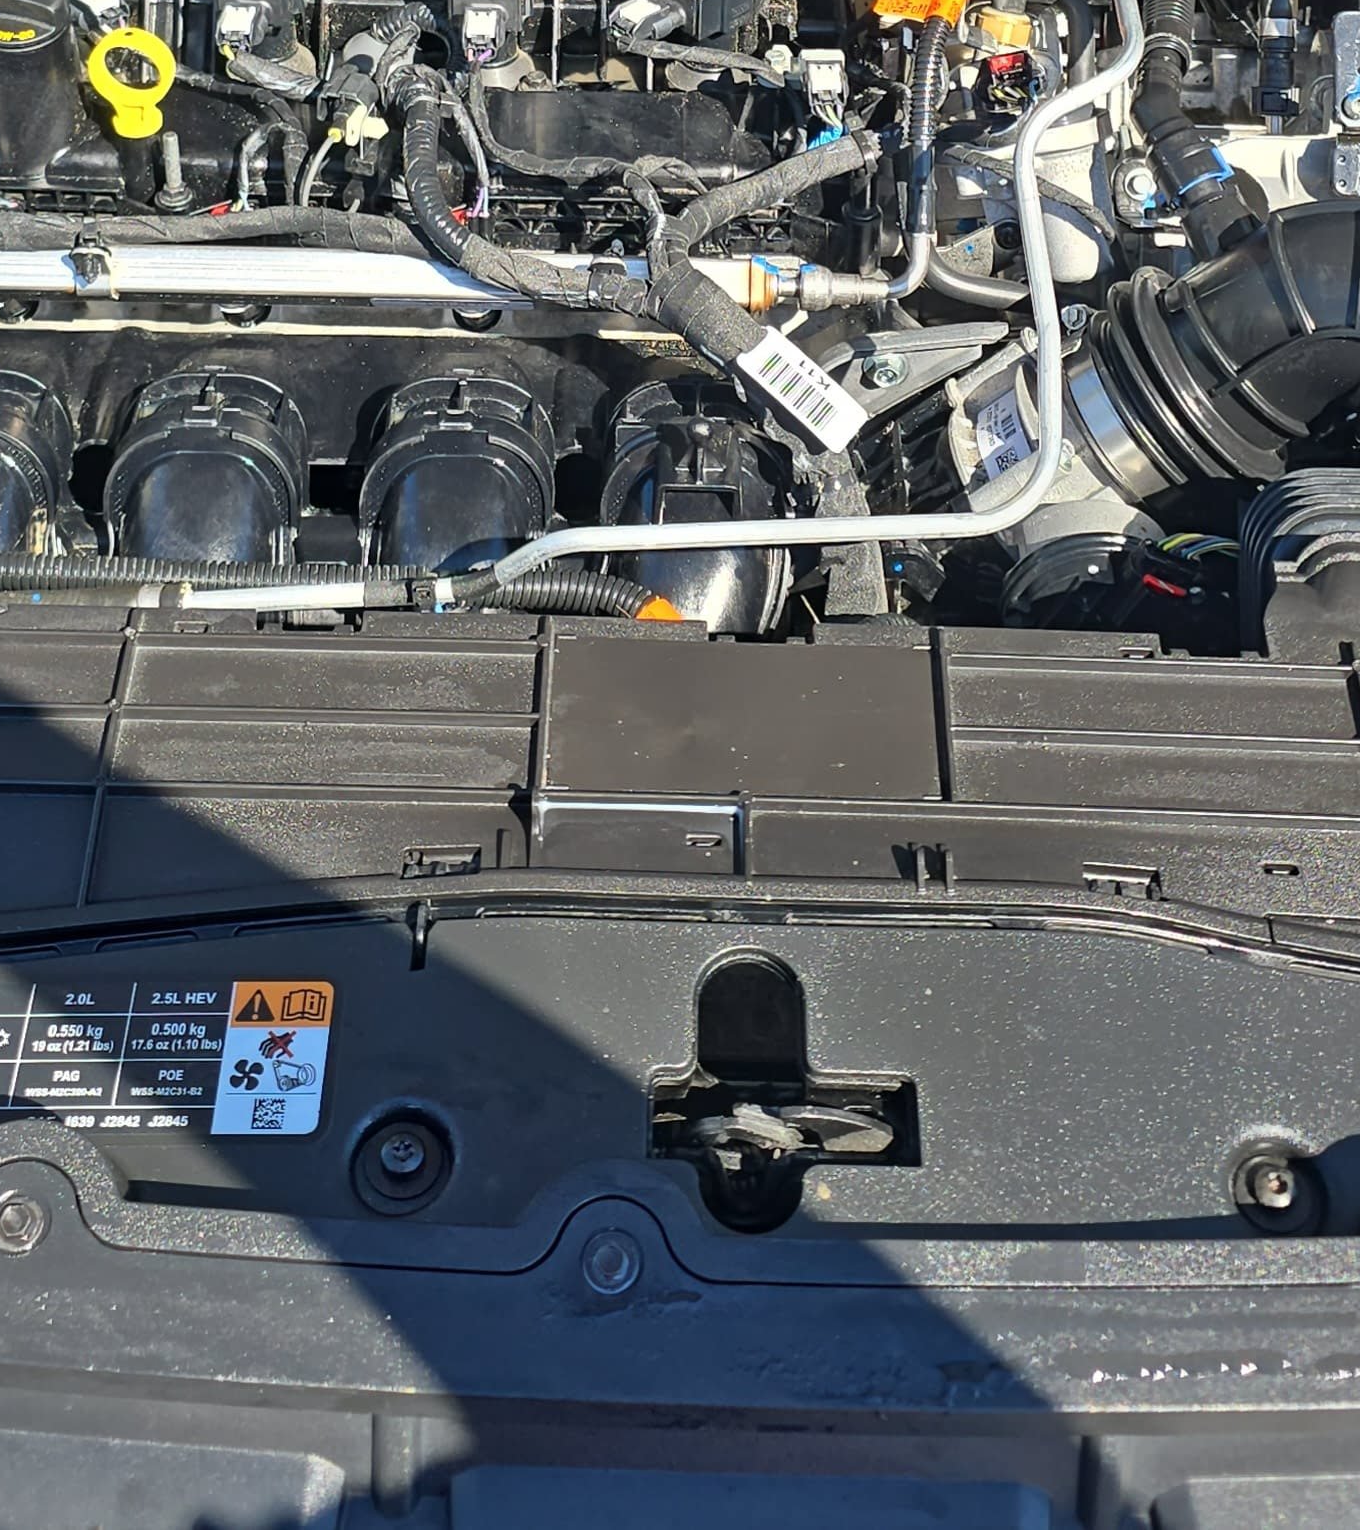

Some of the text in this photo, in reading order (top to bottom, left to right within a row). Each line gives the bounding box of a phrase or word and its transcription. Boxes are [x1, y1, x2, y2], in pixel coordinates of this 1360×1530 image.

[64, 993, 96, 1005] 2.0L
[151, 992, 217, 1005] 2.5L HEV
[47, 1024, 104, 1040] 0.550 kg
[151, 1023, 207, 1038] 0.500 kg
[31, 1041, 47, 1052] 19
[47, 1043, 62, 1052] oz
[92, 1040, 115, 1054] lbs)
[131, 1038, 222, 1052] 17.6 oz (1.10 lbs)
[52, 1070, 81, 1082] PAG
[158, 1069, 185, 1082] POE
[99, 1115, 141, 1128] J2842
[147, 1115, 189, 1127] J2845
